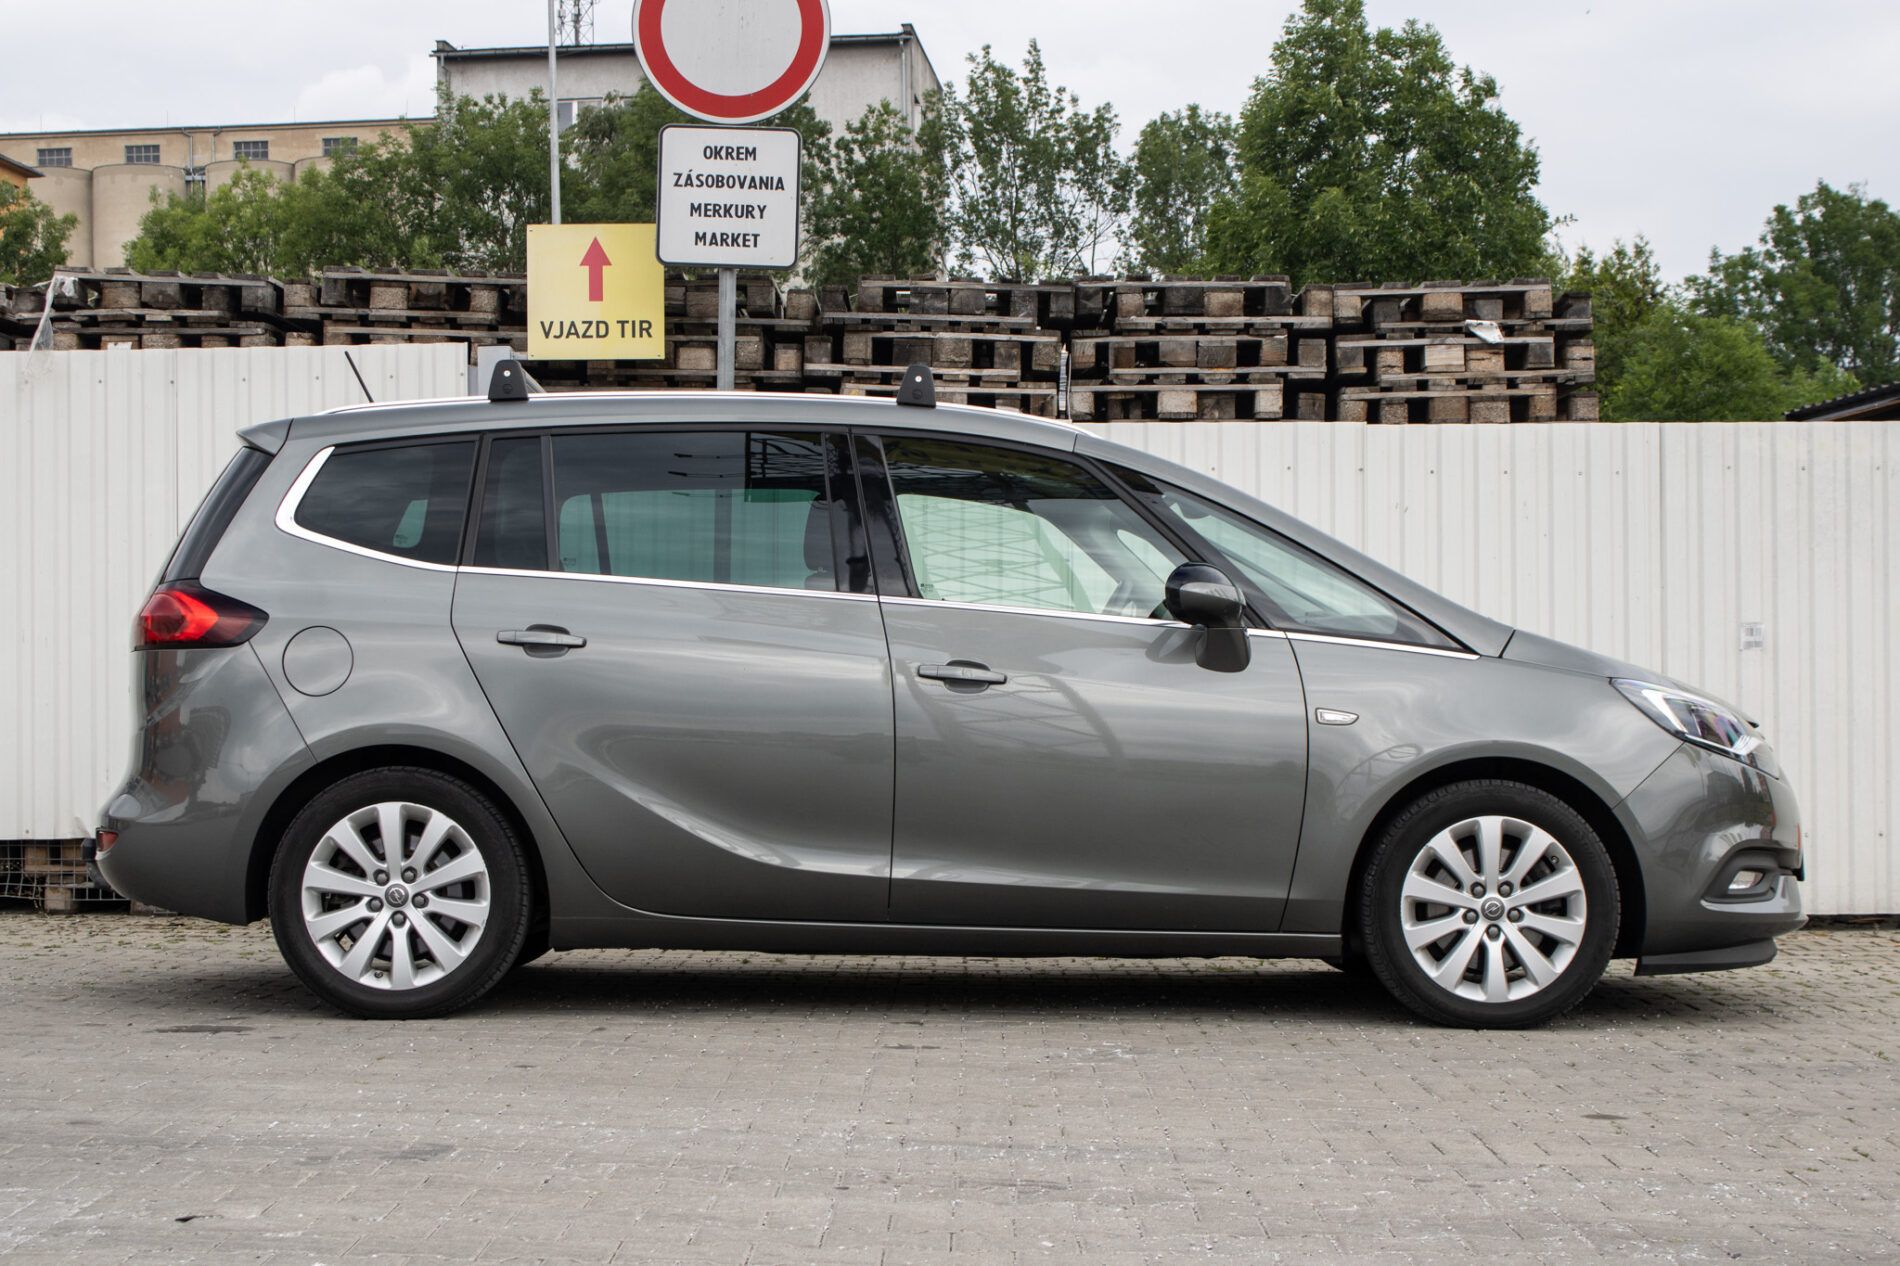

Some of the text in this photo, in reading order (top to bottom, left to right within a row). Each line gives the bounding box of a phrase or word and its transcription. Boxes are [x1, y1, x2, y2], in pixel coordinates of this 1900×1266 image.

[703, 145, 757, 161] OKREM
[673, 169, 785, 191] ZÁSOBOVANIA
[690, 203, 767, 219] MERKURY
[694, 231, 760, 247] MARKET
[540, 319, 653, 339] VJAZD TIR
